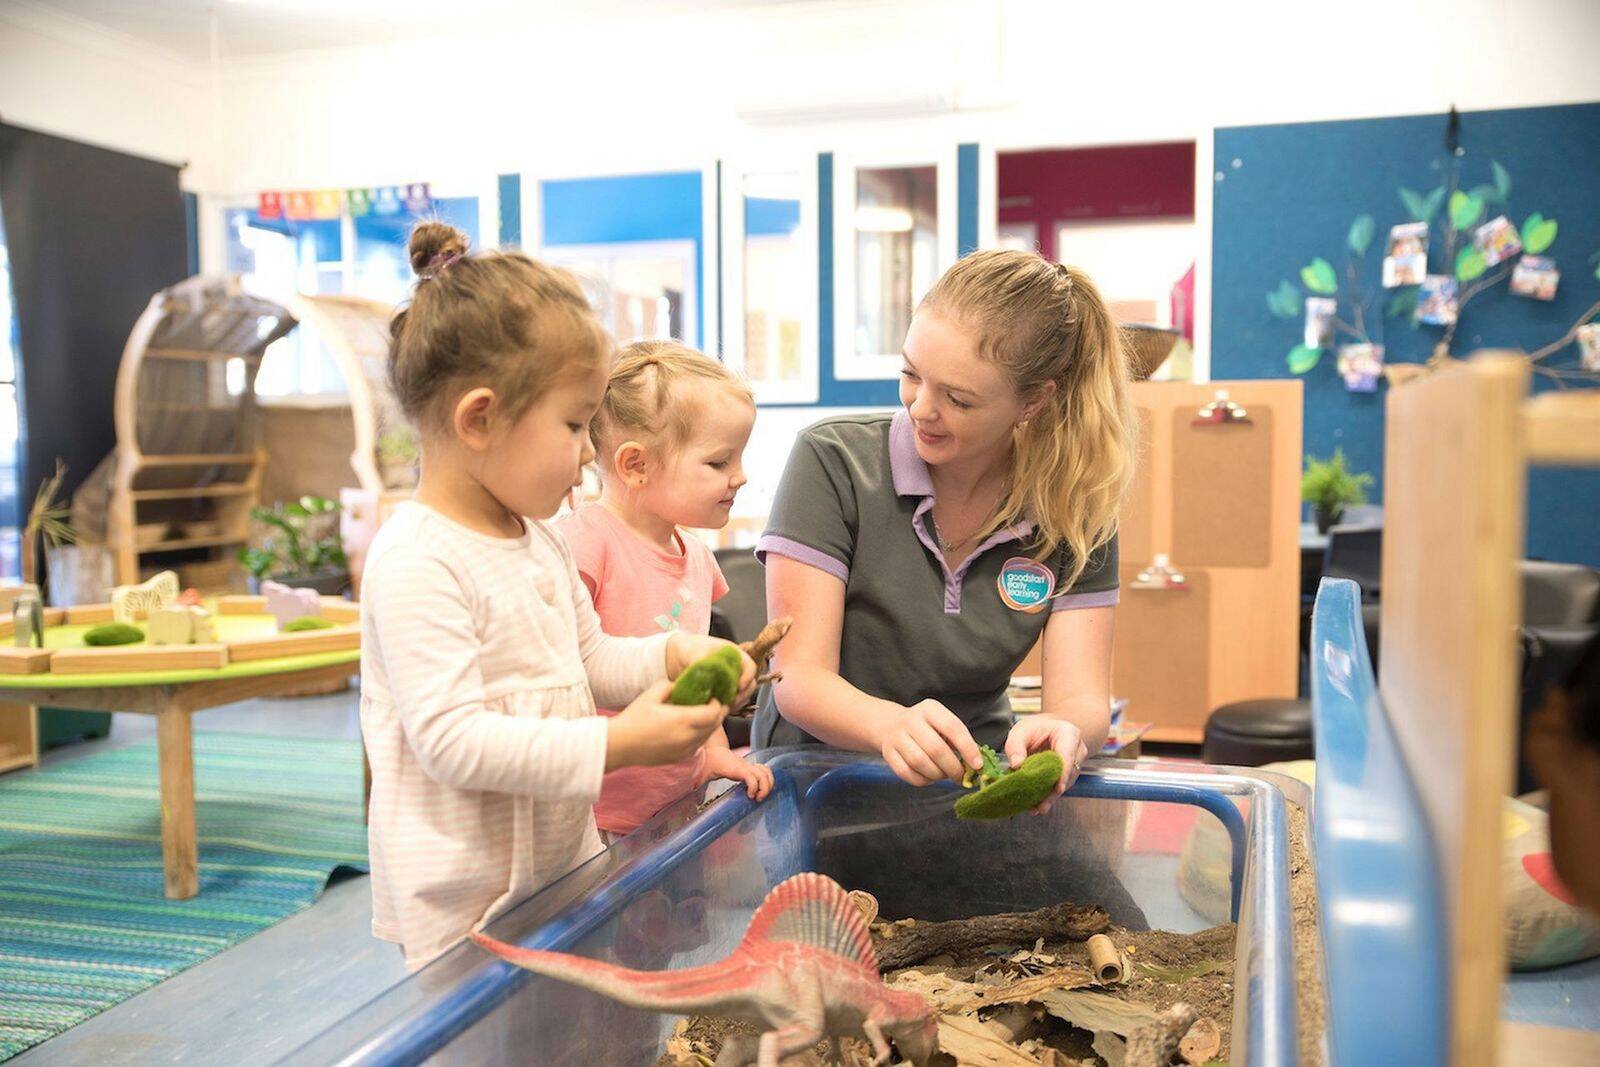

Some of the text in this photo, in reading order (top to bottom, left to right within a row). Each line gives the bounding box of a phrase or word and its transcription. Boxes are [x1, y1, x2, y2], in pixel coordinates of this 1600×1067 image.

[1007, 573, 1045, 583] goodstart
[1007, 581, 1028, 590] early
[1008, 587, 1040, 600] learning
